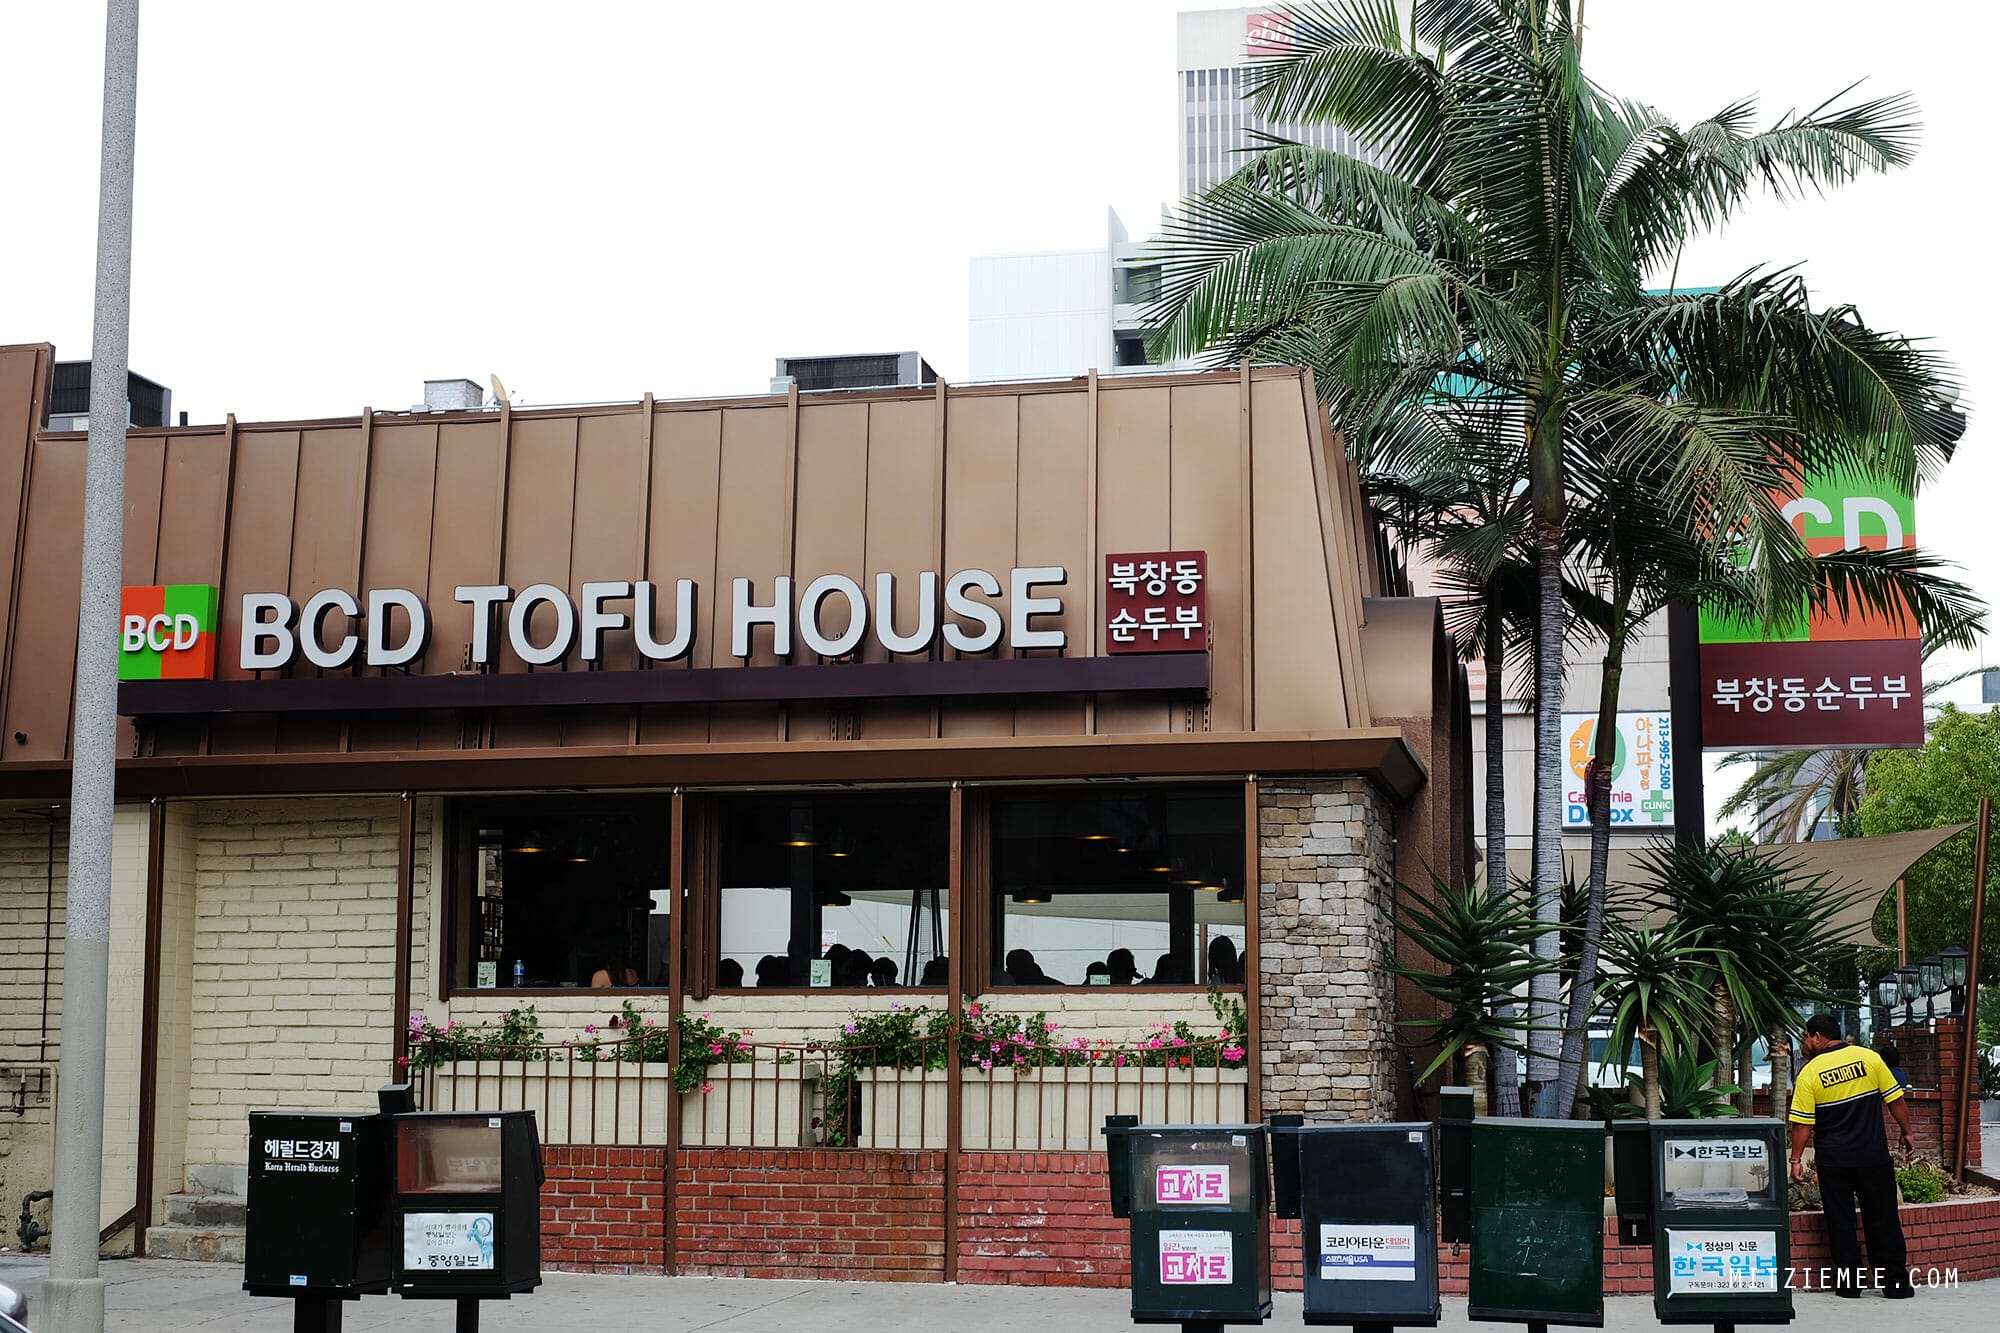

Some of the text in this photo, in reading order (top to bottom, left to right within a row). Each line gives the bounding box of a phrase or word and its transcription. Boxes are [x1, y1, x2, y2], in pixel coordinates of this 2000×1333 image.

[1107, 559, 1203, 597] 북창동
[239, 566, 1067, 671] BCD TOFU HOUSE
[1108, 604, 1203, 643] 순두부
[122, 614, 200, 653] BCD
[1712, 674, 1912, 714] 북창동순두부
[1658, 717, 1671, 790] 213-995-2500
[1567, 790, 1633, 803] Cania
[1642, 800, 1671, 810] CLINIC
[1568, 805, 1634, 823] Dox
[1820, 1062, 1864, 1087] SECURITY
[264, 1138, 340, 1160] 헤럴드경제
[1697, 1145, 1763, 1159] 한국일보
[264, 1161, 340, 1173] Korea Herald Business
[1161, 1171, 1224, 1199] 교차로
[1326, 1236, 1385, 1249] 코리아타운
[1704, 1241, 1758, 1252] 정상의 신문
[428, 1254, 479, 1268] 중앙일보
[1166, 1254, 1227, 1280] 교차로
[1672, 1254, 1777, 1277] 한국일보
